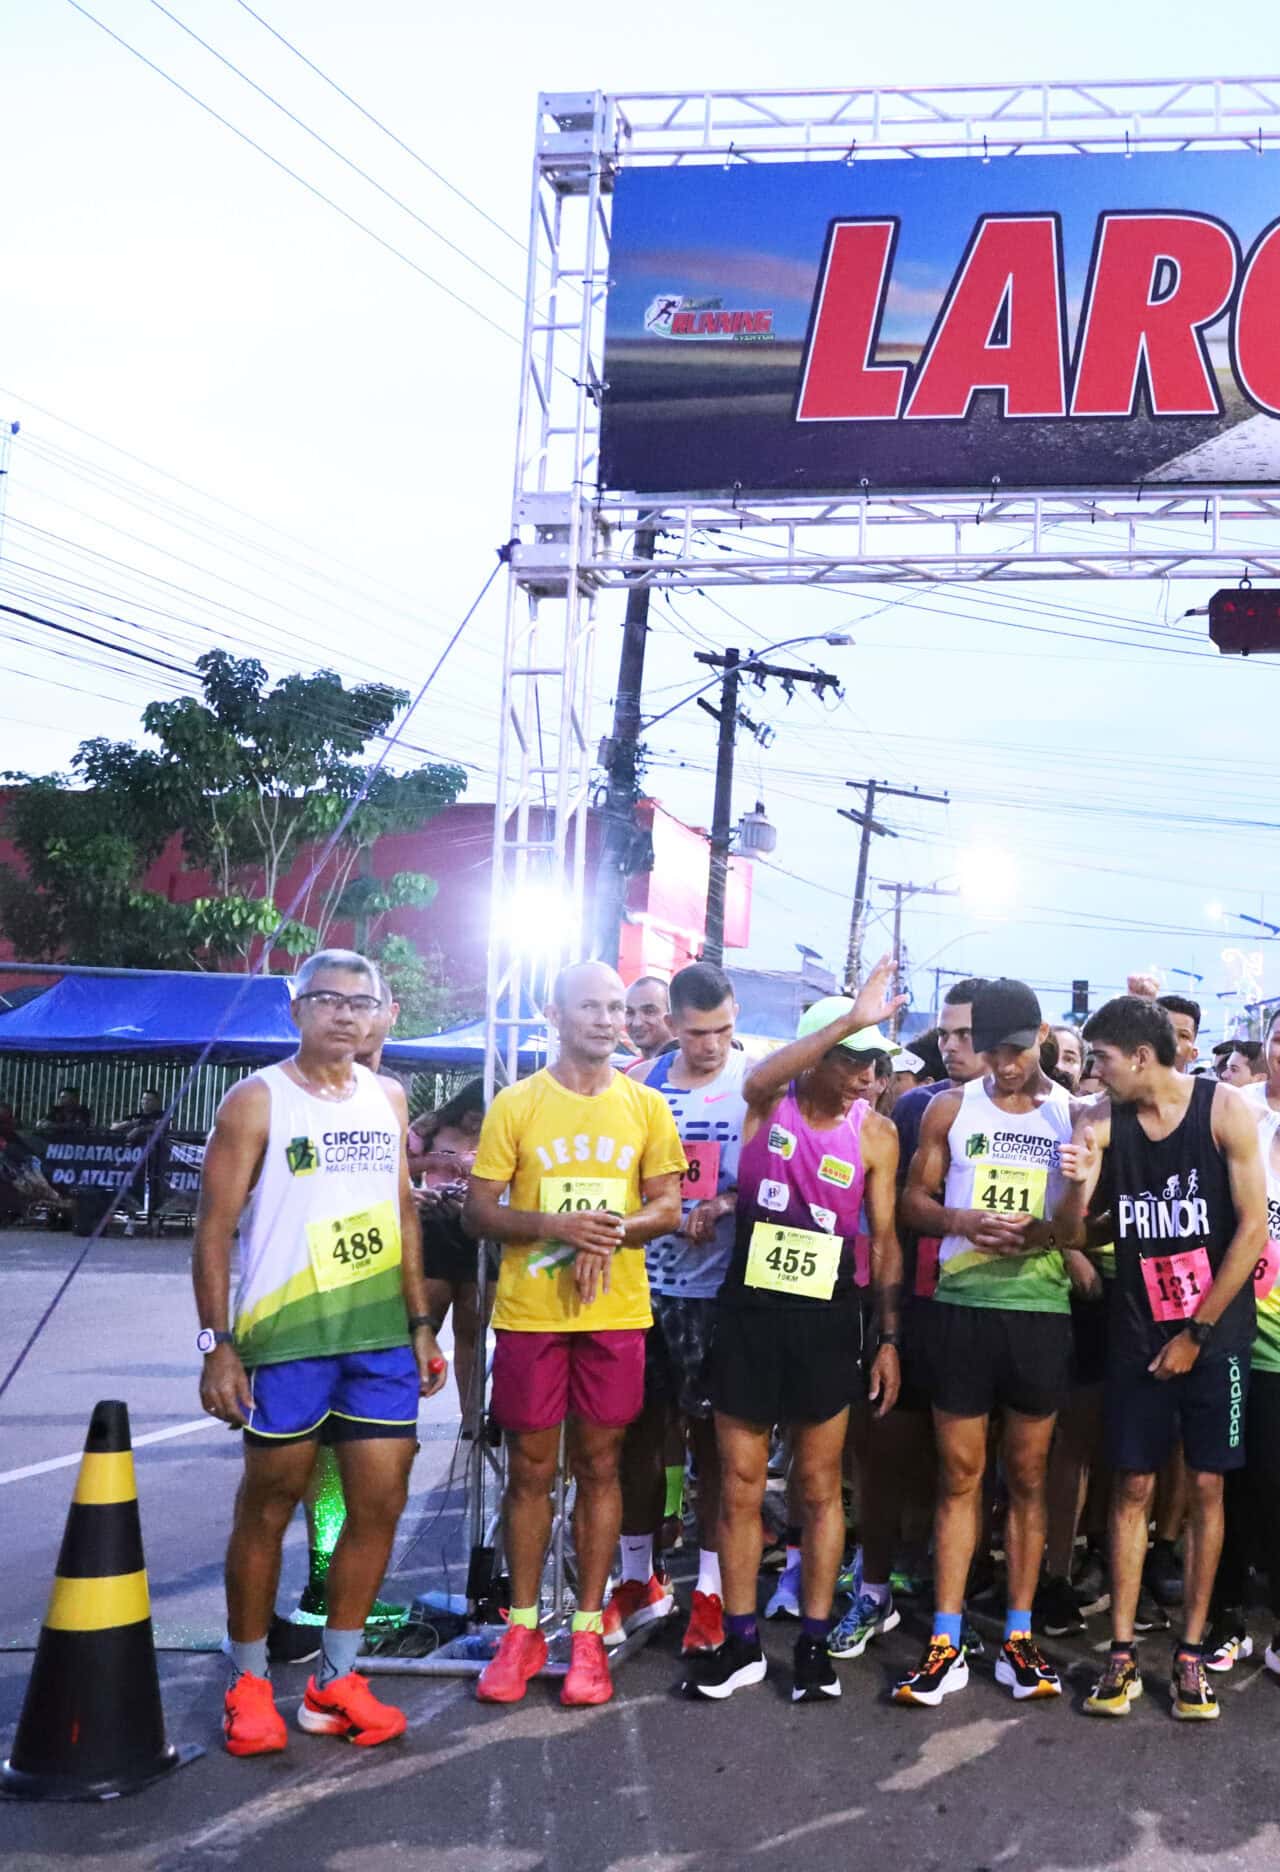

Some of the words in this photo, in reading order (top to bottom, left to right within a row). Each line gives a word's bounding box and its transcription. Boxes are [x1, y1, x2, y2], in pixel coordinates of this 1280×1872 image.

[671, 310, 773, 335] RUNNING
[322, 1130, 391, 1146] CIRCUITO
[992, 1141, 1061, 1161] CORRIDAS
[993, 1131, 1052, 1149] CIRCUITO
[325, 1145, 393, 1164] CORRIDA
[535, 1133, 636, 1172] JESUS
[52, 1168, 76, 1185] DO
[78, 1169, 135, 1187] ATLETA
[981, 1184, 1031, 1213] 441
[332, 1227, 384, 1265] 488
[765, 1246, 819, 1277] 455
[1157, 1271, 1201, 1301] 131
[1229, 1363, 1241, 1448] adidas
